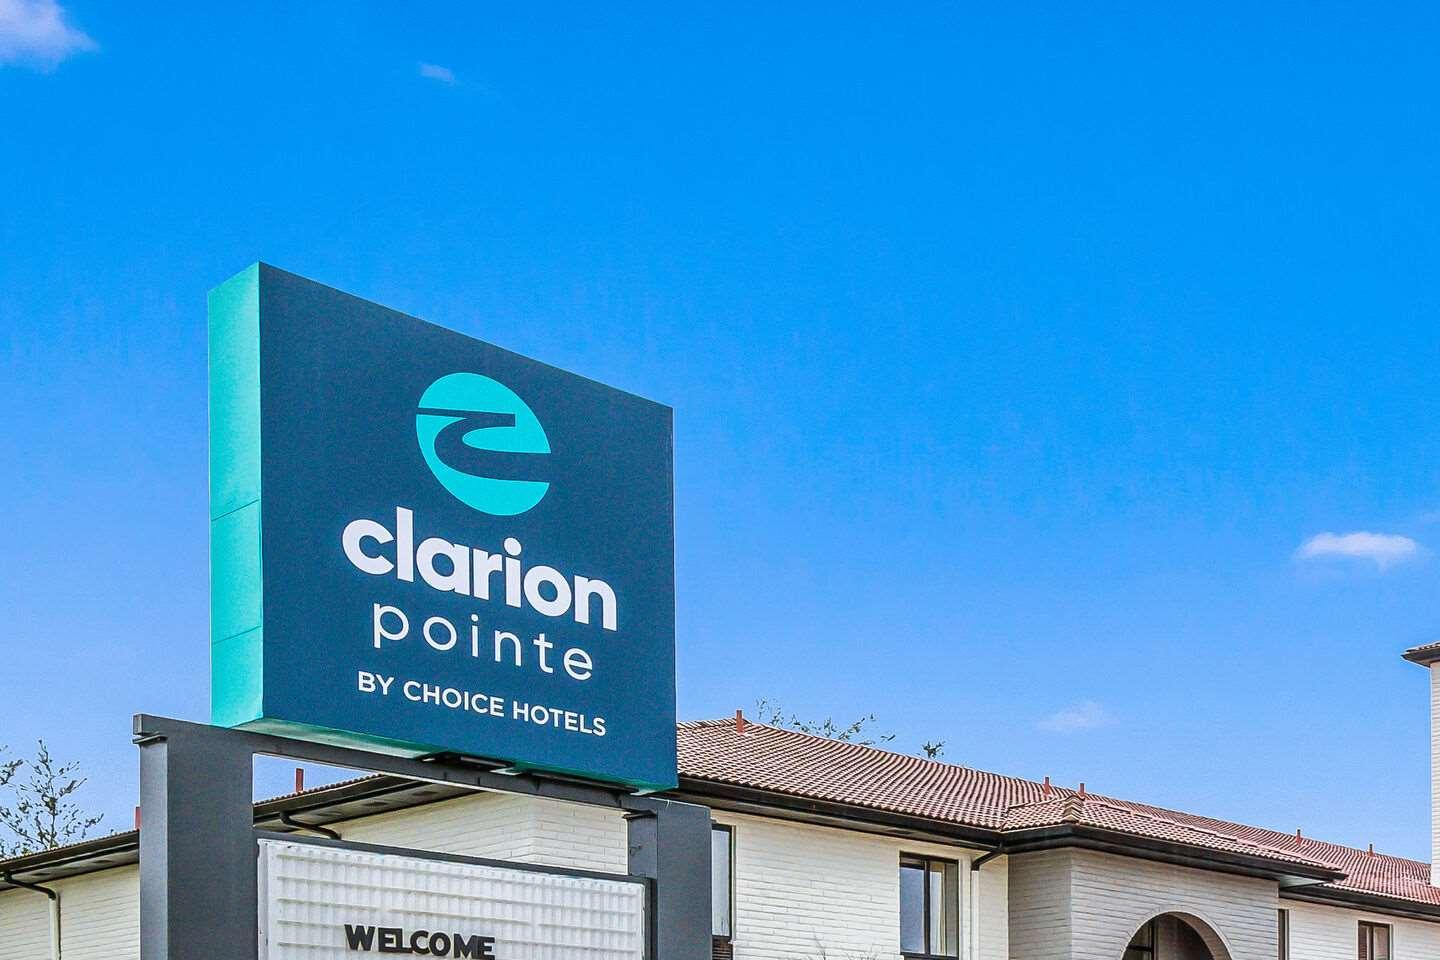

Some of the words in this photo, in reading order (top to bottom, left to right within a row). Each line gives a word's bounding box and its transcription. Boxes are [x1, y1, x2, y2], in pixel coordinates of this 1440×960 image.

[342, 506, 617, 632] clarion
[373, 603, 593, 681] pointe
[358, 670, 395, 696] BY
[403, 679, 505, 718] CHOICE
[512, 700, 607, 737] HOTELS
